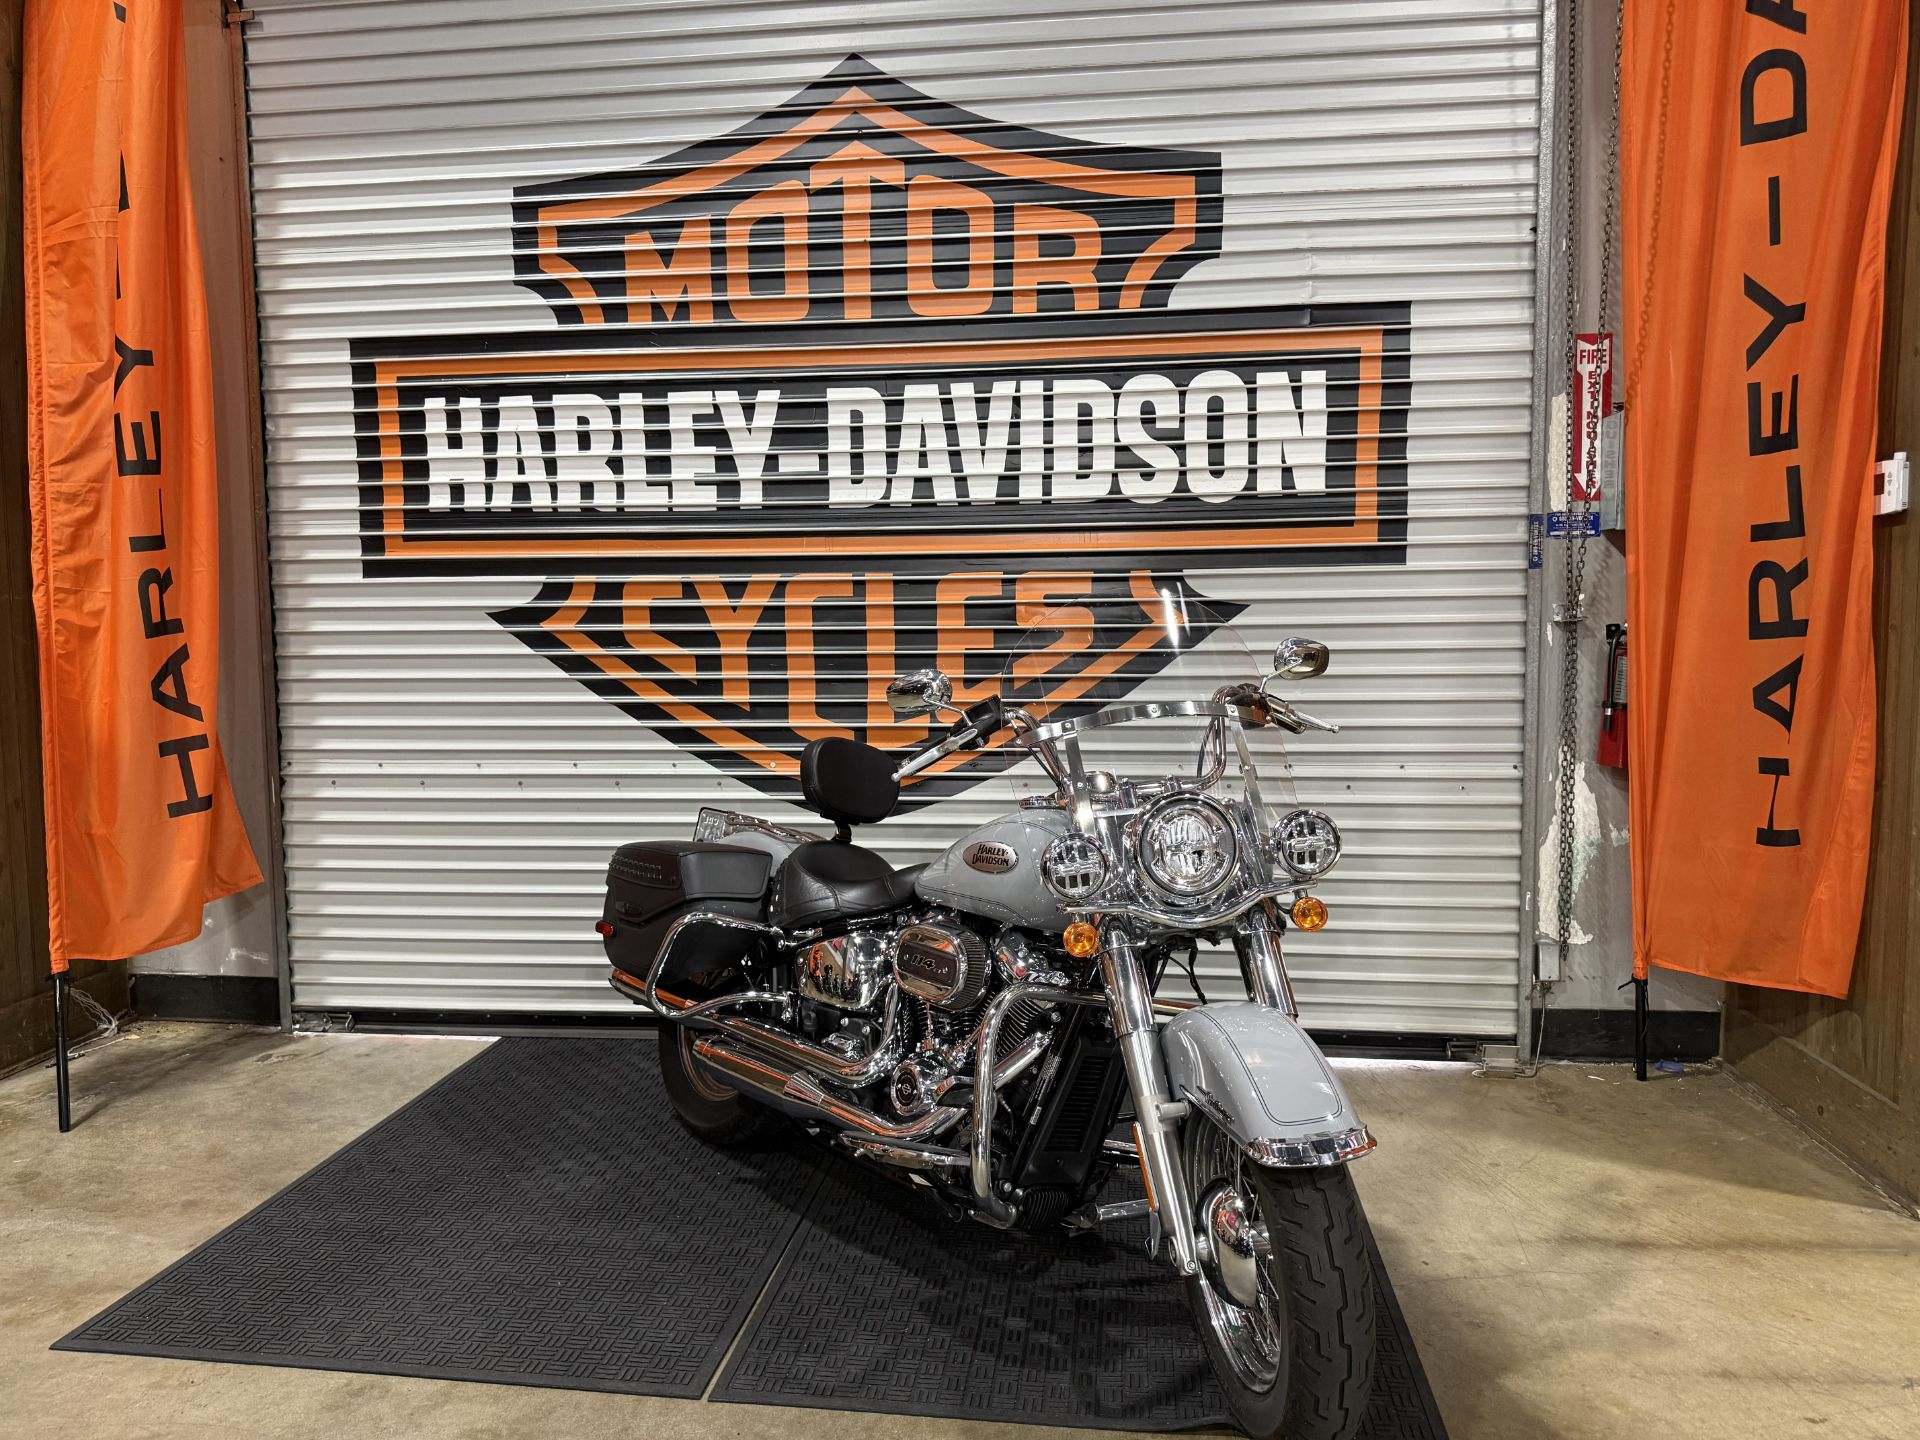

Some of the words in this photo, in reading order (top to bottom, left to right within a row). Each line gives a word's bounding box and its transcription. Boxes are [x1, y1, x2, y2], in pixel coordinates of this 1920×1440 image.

[624, 140, 1103, 324] MOTOR
[1579, 349, 1607, 364] FIRE
[422, 369, 1328, 512] HARLEY-DAVIDSON
[622, 571, 1095, 749] CYCLES
[971, 853, 1010, 867] DAVIDSON
[911, 954, 936, 969] 114
